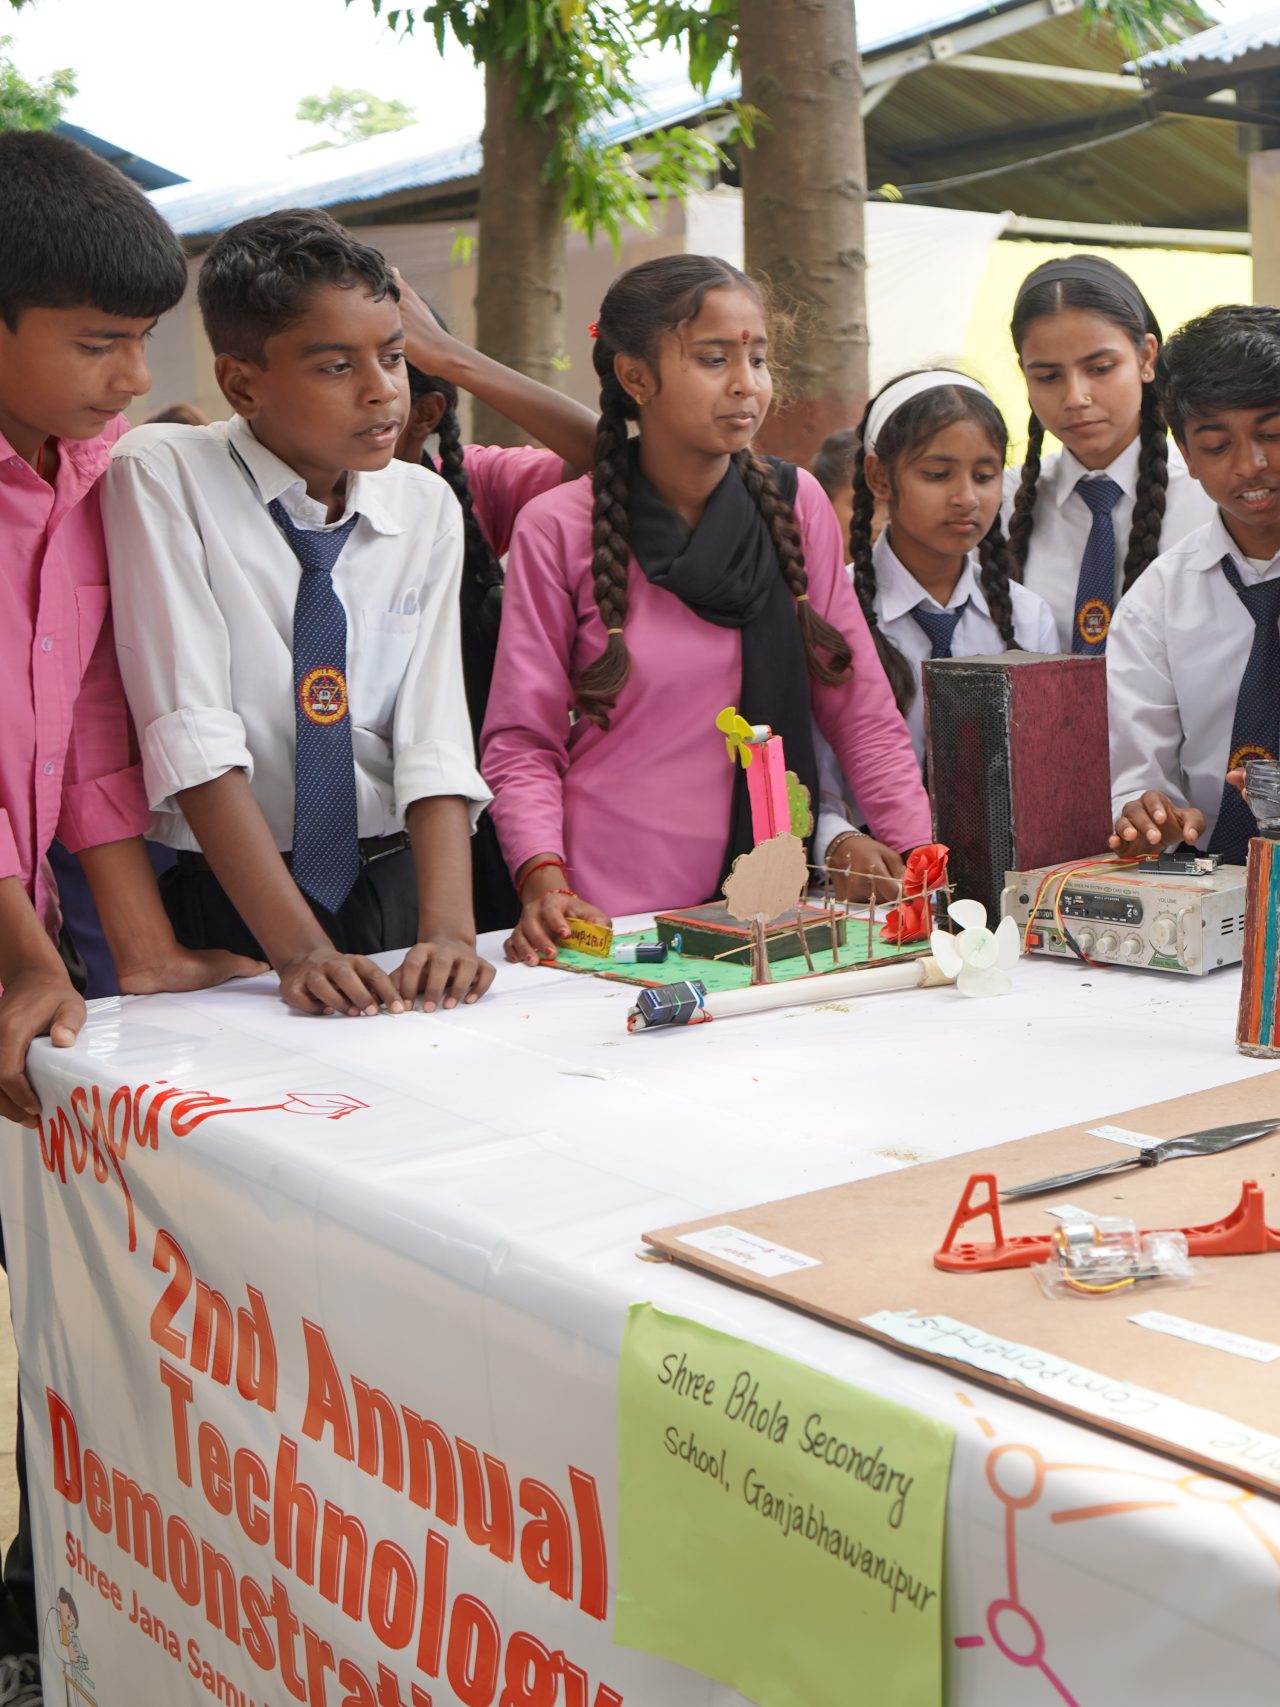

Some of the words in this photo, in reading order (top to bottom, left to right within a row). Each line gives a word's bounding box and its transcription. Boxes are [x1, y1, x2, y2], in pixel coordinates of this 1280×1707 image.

[150, 1228, 279, 1413] 2nd
[301, 1316, 609, 1622] Annual
[657, 1353, 716, 1406] Shree
[724, 1371, 789, 1444] Bhola
[799, 1413, 914, 1529] Secondary
[65, 1530, 123, 1611] Shree
[128, 1589, 182, 1663] Jana
[663, 1426, 730, 1492] School,
[743, 1468, 937, 1613] Ganjabhawanipur
